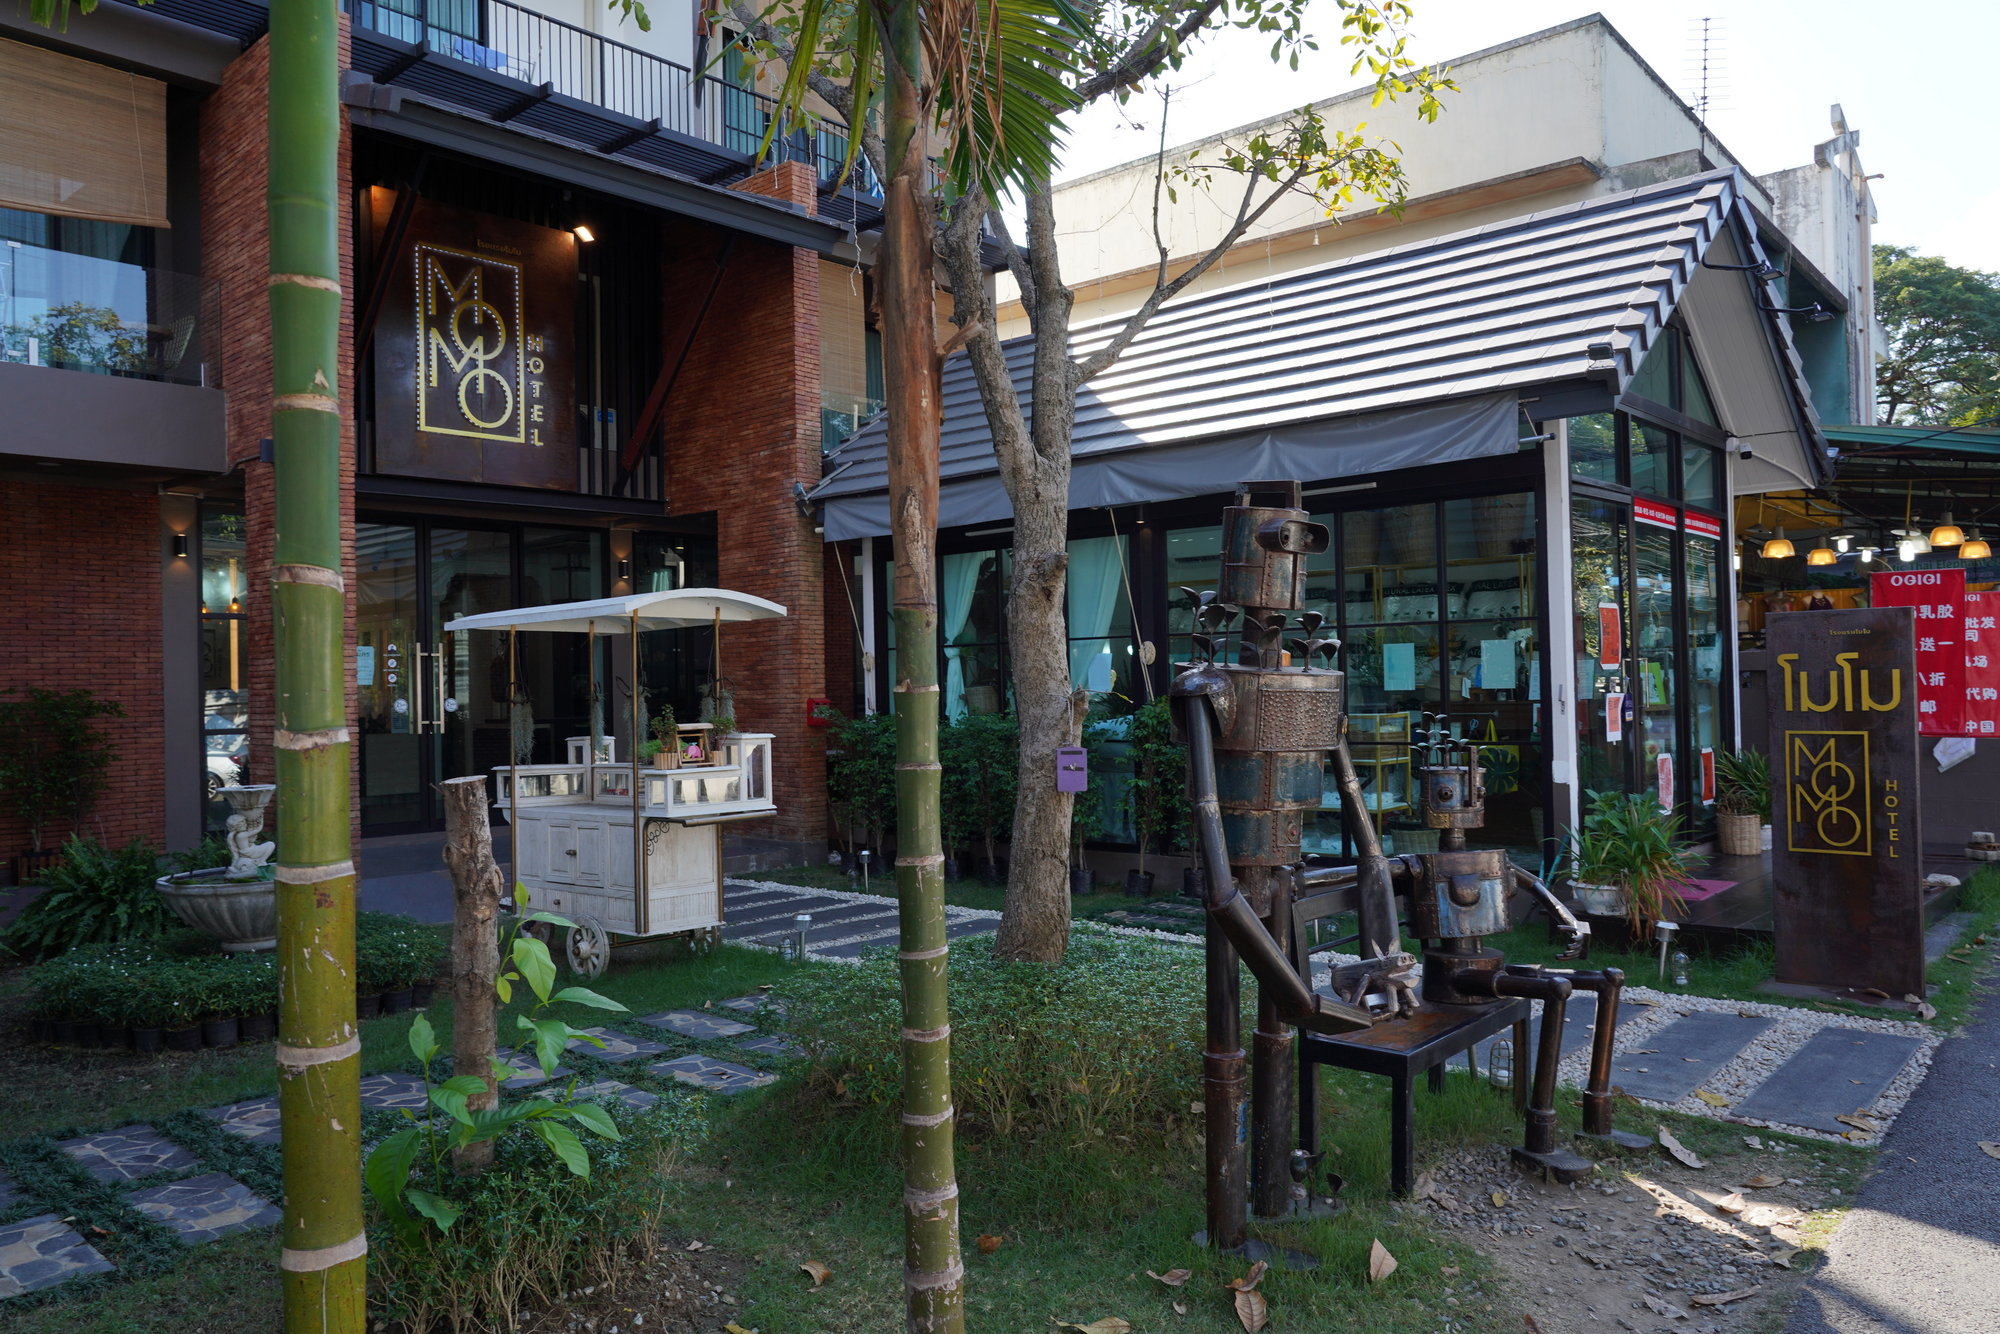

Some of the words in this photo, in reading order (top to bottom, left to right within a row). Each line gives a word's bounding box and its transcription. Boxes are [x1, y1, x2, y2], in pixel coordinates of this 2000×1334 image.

[526, 333, 545, 447] HOTEL
[1890, 573, 1941, 587] OGIGI
[1964, 594, 1981, 602] IGI
[1919, 637, 1955, 652] 送一
[1776, 652, 1901, 713] โมโม
[1920, 699, 1937, 714] 邮
[1965, 719, 1995, 734] 中国
[1884, 779, 1900, 858] HOTEL
